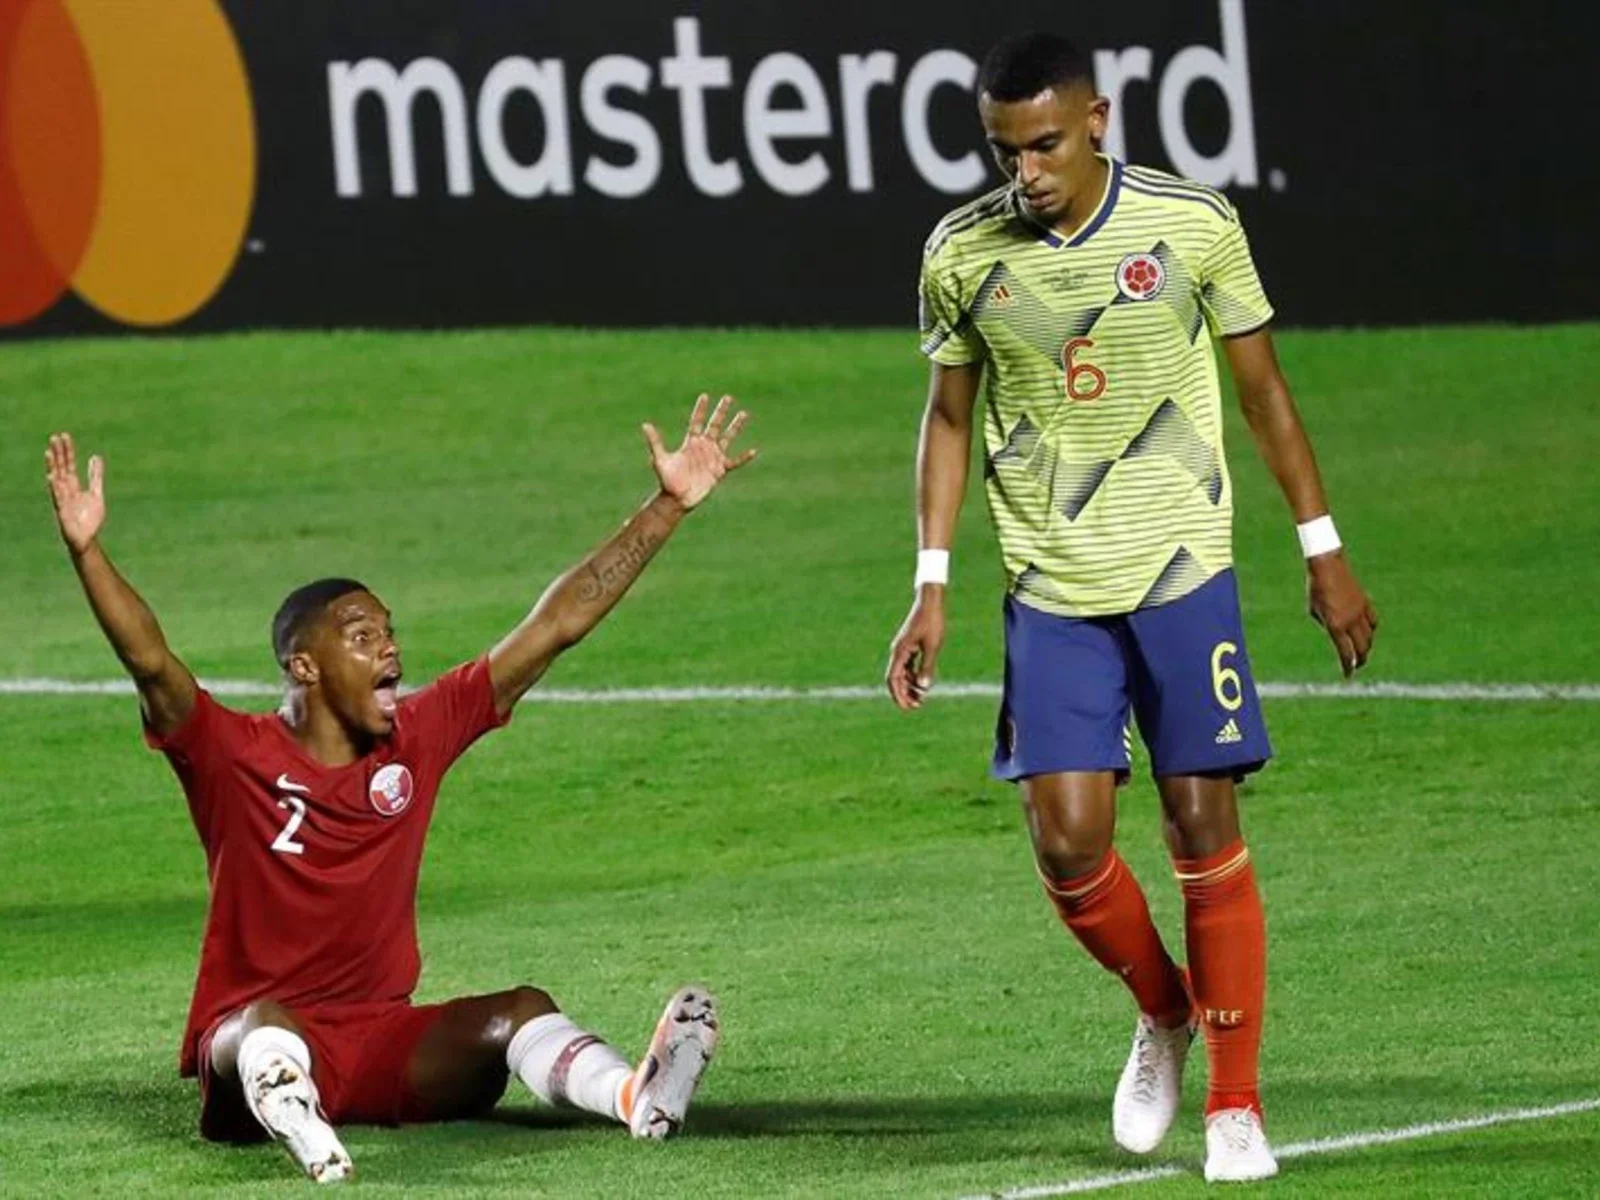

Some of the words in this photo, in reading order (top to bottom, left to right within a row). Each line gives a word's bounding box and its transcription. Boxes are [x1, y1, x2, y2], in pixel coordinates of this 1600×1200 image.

[327, 0, 1259, 198] mastercrd
[1062, 337, 1107, 402] 6
[1211, 641, 1243, 711] 6
[270, 796, 306, 854] 2
